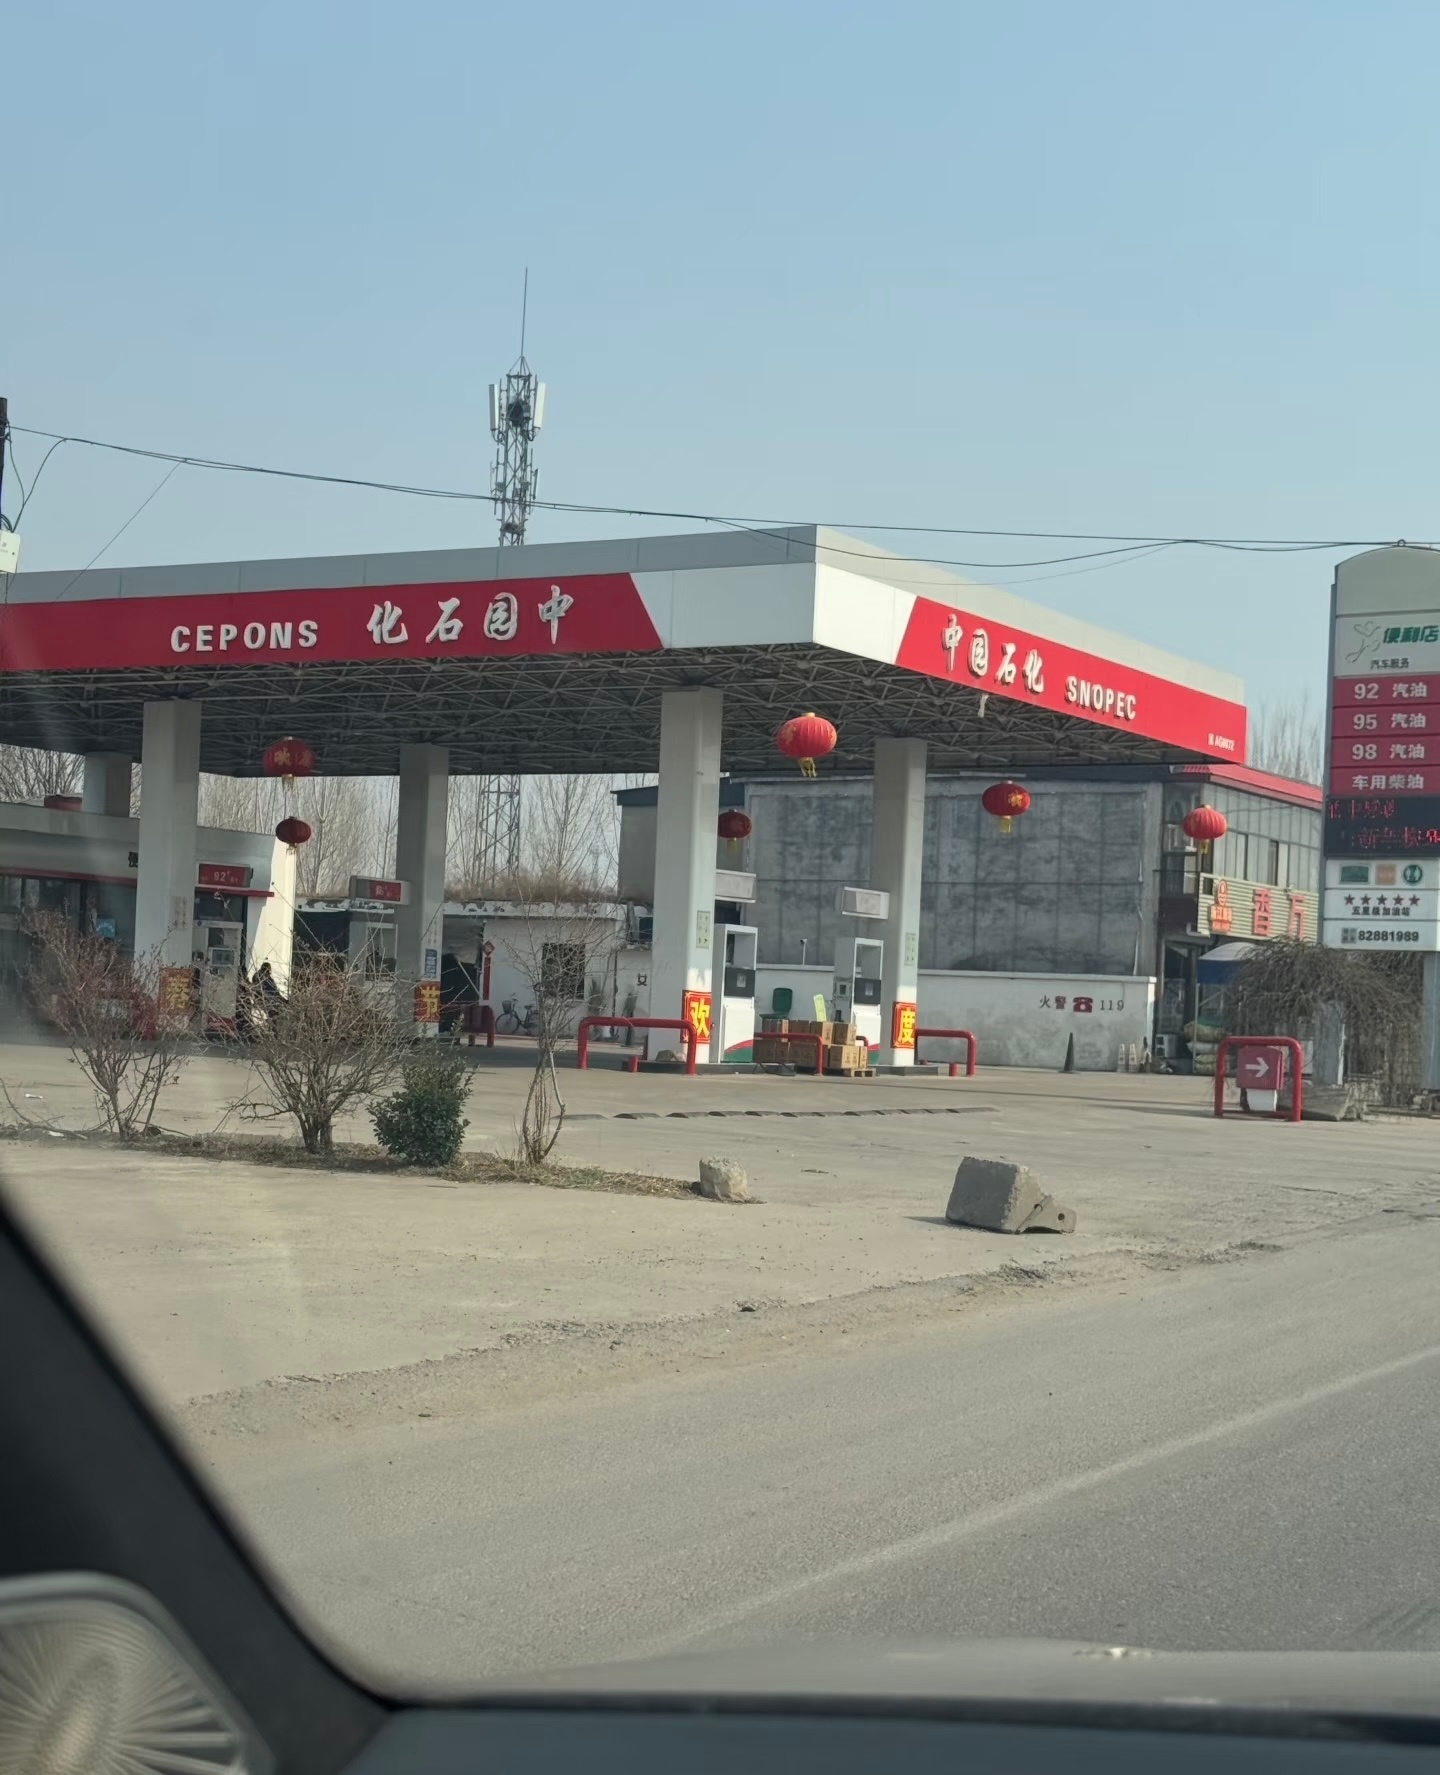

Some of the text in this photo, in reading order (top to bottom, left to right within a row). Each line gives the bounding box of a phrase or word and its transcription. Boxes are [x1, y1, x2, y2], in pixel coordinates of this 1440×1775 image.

[170, 619, 319, 653] CEPONS
[1383, 624, 1440, 644] 便利店
[941, 613, 1137, 721] 中国石化 SNOPEC
[1370, 657, 1410, 670] 汽车服务
[1353, 681, 1428, 700] 92 汽油
[1353, 712, 1427, 730] 95 汽油
[1351, 743, 1425, 760] 98 汽油
[1351, 774, 1425, 791] 车用柴油
[1351, 905, 1411, 917] 五星级加油站
[1358, 929, 1420, 942] 82881989
[1039, 993, 1125, 1012] 火警 119
[689, 996, 711, 1039] 欢
[897, 1006, 917, 1046] 度
